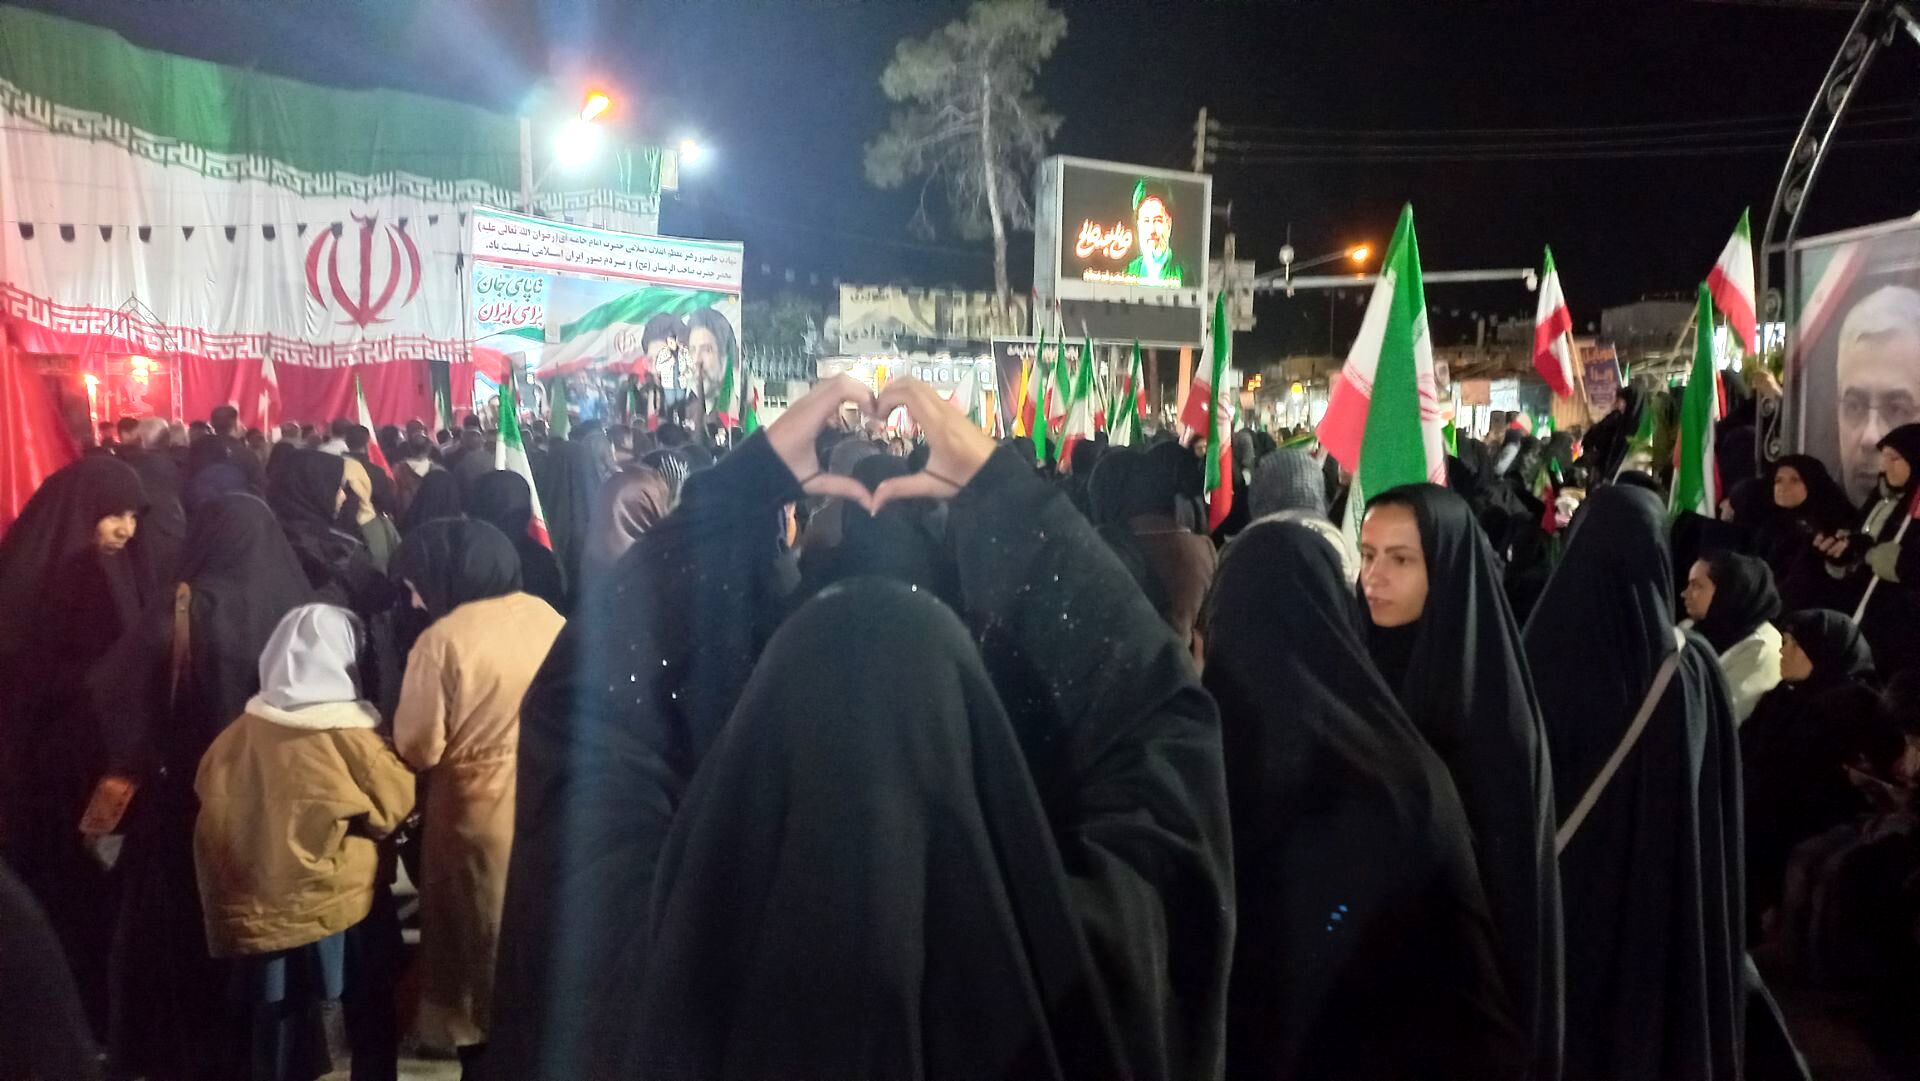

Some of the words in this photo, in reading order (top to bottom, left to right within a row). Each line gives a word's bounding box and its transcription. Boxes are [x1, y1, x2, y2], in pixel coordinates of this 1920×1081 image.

[501, 242, 530, 255] تسلیت
[588, 238, 602, 247] امام
[625, 244, 647, 253] اسلامی
[531, 246, 564, 257] اسلامی
[565, 250, 584, 261] ایران
[635, 259, 651, 271] (عج)
[652, 262, 676, 275] الزمان
[477, 273, 506, 298] جان
[478, 302, 512, 325] ایران
[511, 305, 544, 327] برای
